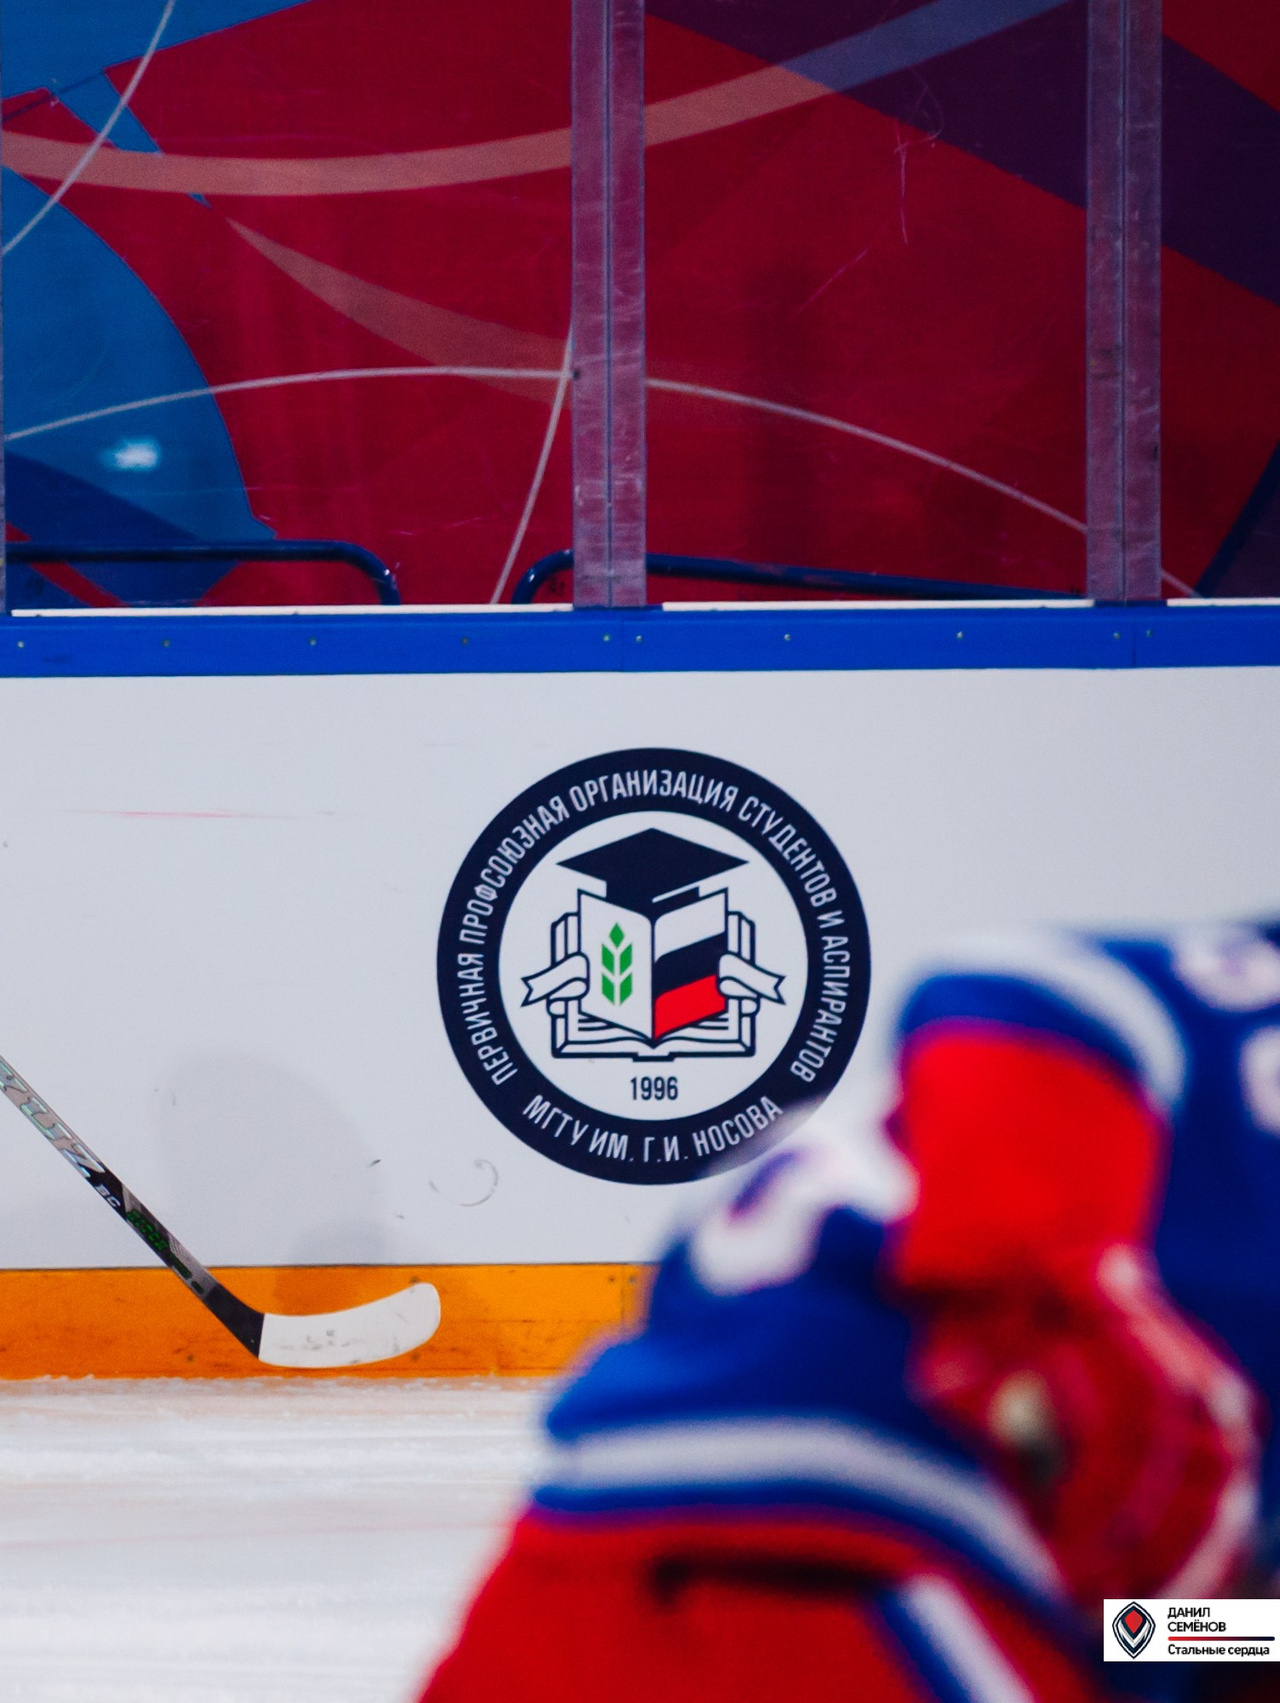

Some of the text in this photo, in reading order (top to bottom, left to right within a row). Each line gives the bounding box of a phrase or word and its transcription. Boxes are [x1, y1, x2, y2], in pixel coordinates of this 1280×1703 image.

[457, 769, 851, 1086] ПЕРВИЧНАЯ ПРОФСОЮЗНАЯ ОРГАНИЗАЦИЯ СТУДЕНТОВ И АСПИРАНТОВ
[630, 1076, 679, 1101] 1996
[522, 1094, 785, 1162] МГТУ ИМ. Г.И. НОСОВА
